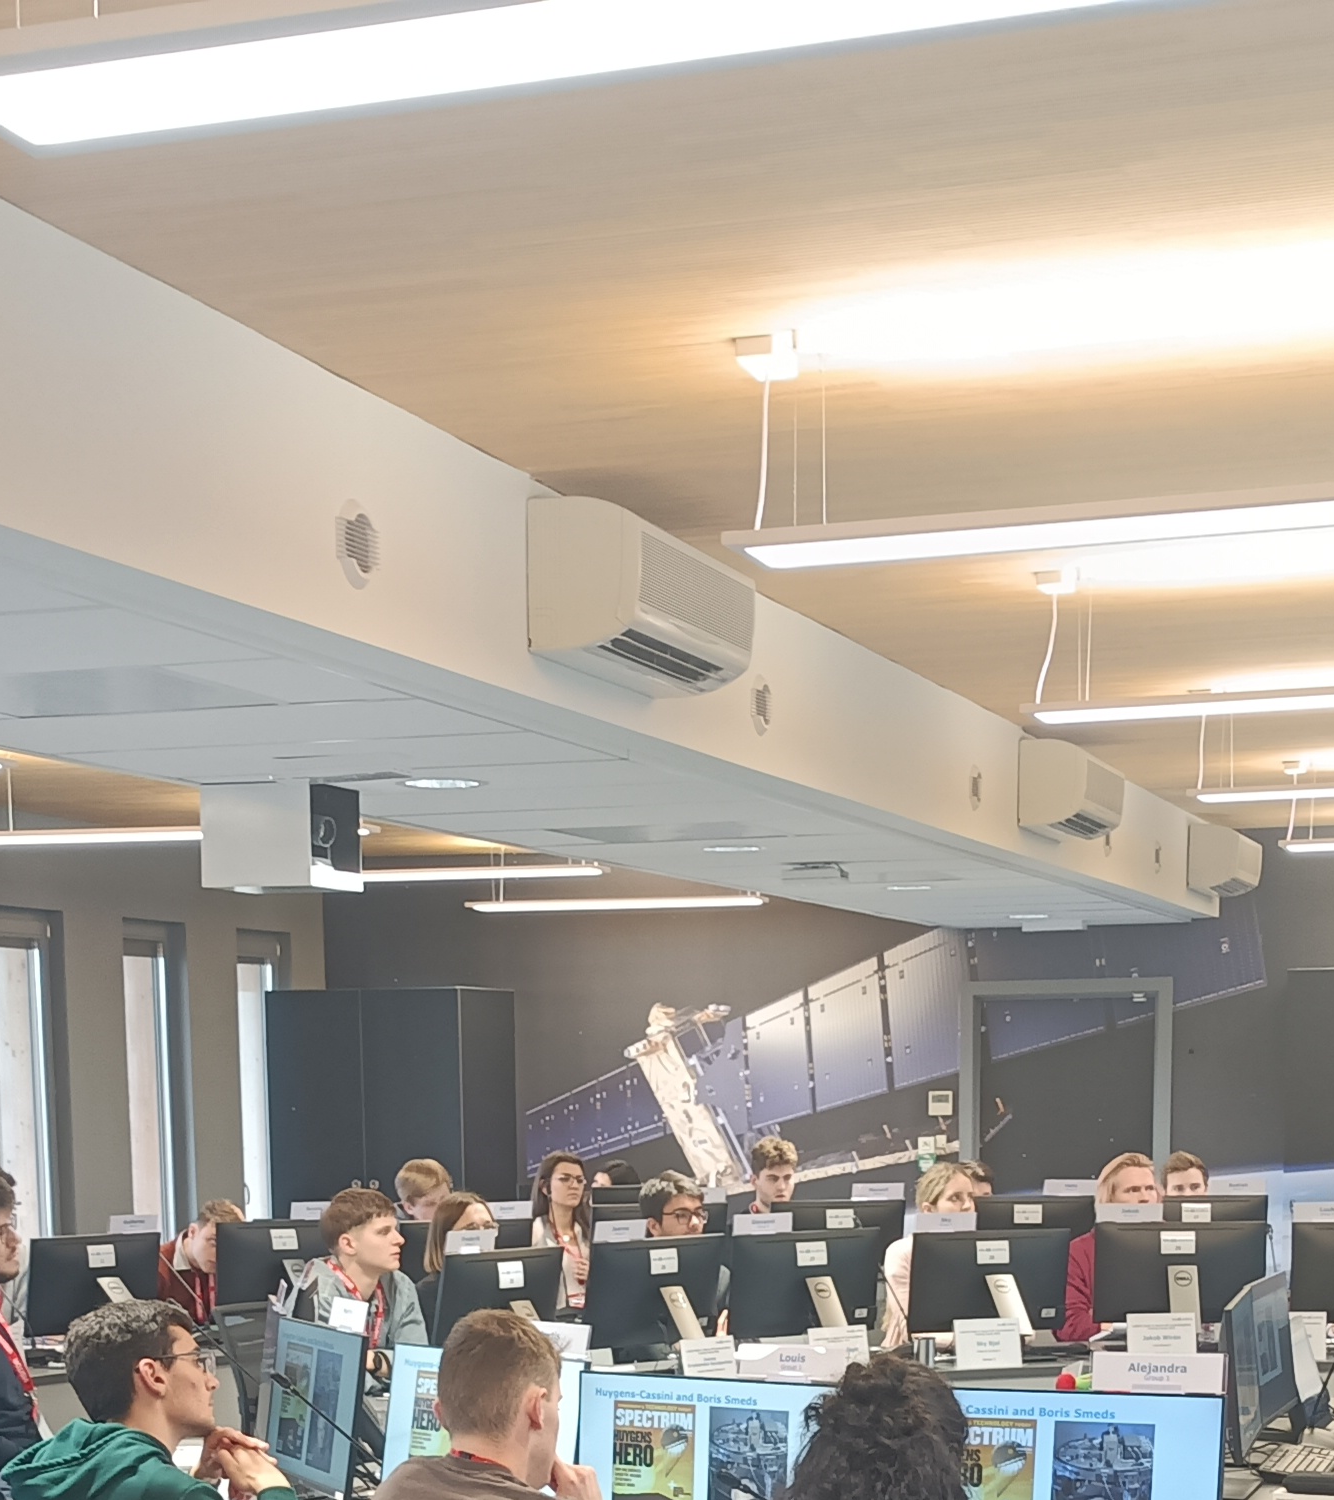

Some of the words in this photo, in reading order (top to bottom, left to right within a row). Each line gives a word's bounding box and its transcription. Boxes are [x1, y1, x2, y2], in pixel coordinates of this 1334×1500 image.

[780, 1353, 805, 1363] Louis
[1128, 1362, 1188, 1377] Alejandra
[1144, 1374, 1164, 1382] Group
[595, 1387, 674, 1402] Huygens-Cassini
[675, 1393, 694, 1403] and
[696, 1394, 722, 1404] Boris
[724, 1395, 758, 1406] Smeds
[615, 1408, 693, 1430] SPECTRUM
[1011, 1406, 1035, 1416] and
[1038, 1407, 1070, 1418] Boris
[1073, 1408, 1116, 1419] Smeds
[614, 1429, 652, 1443] HUYGENS
[964, 1426, 1034, 1447] CTRUM
[612, 1444, 654, 1467] HERO
